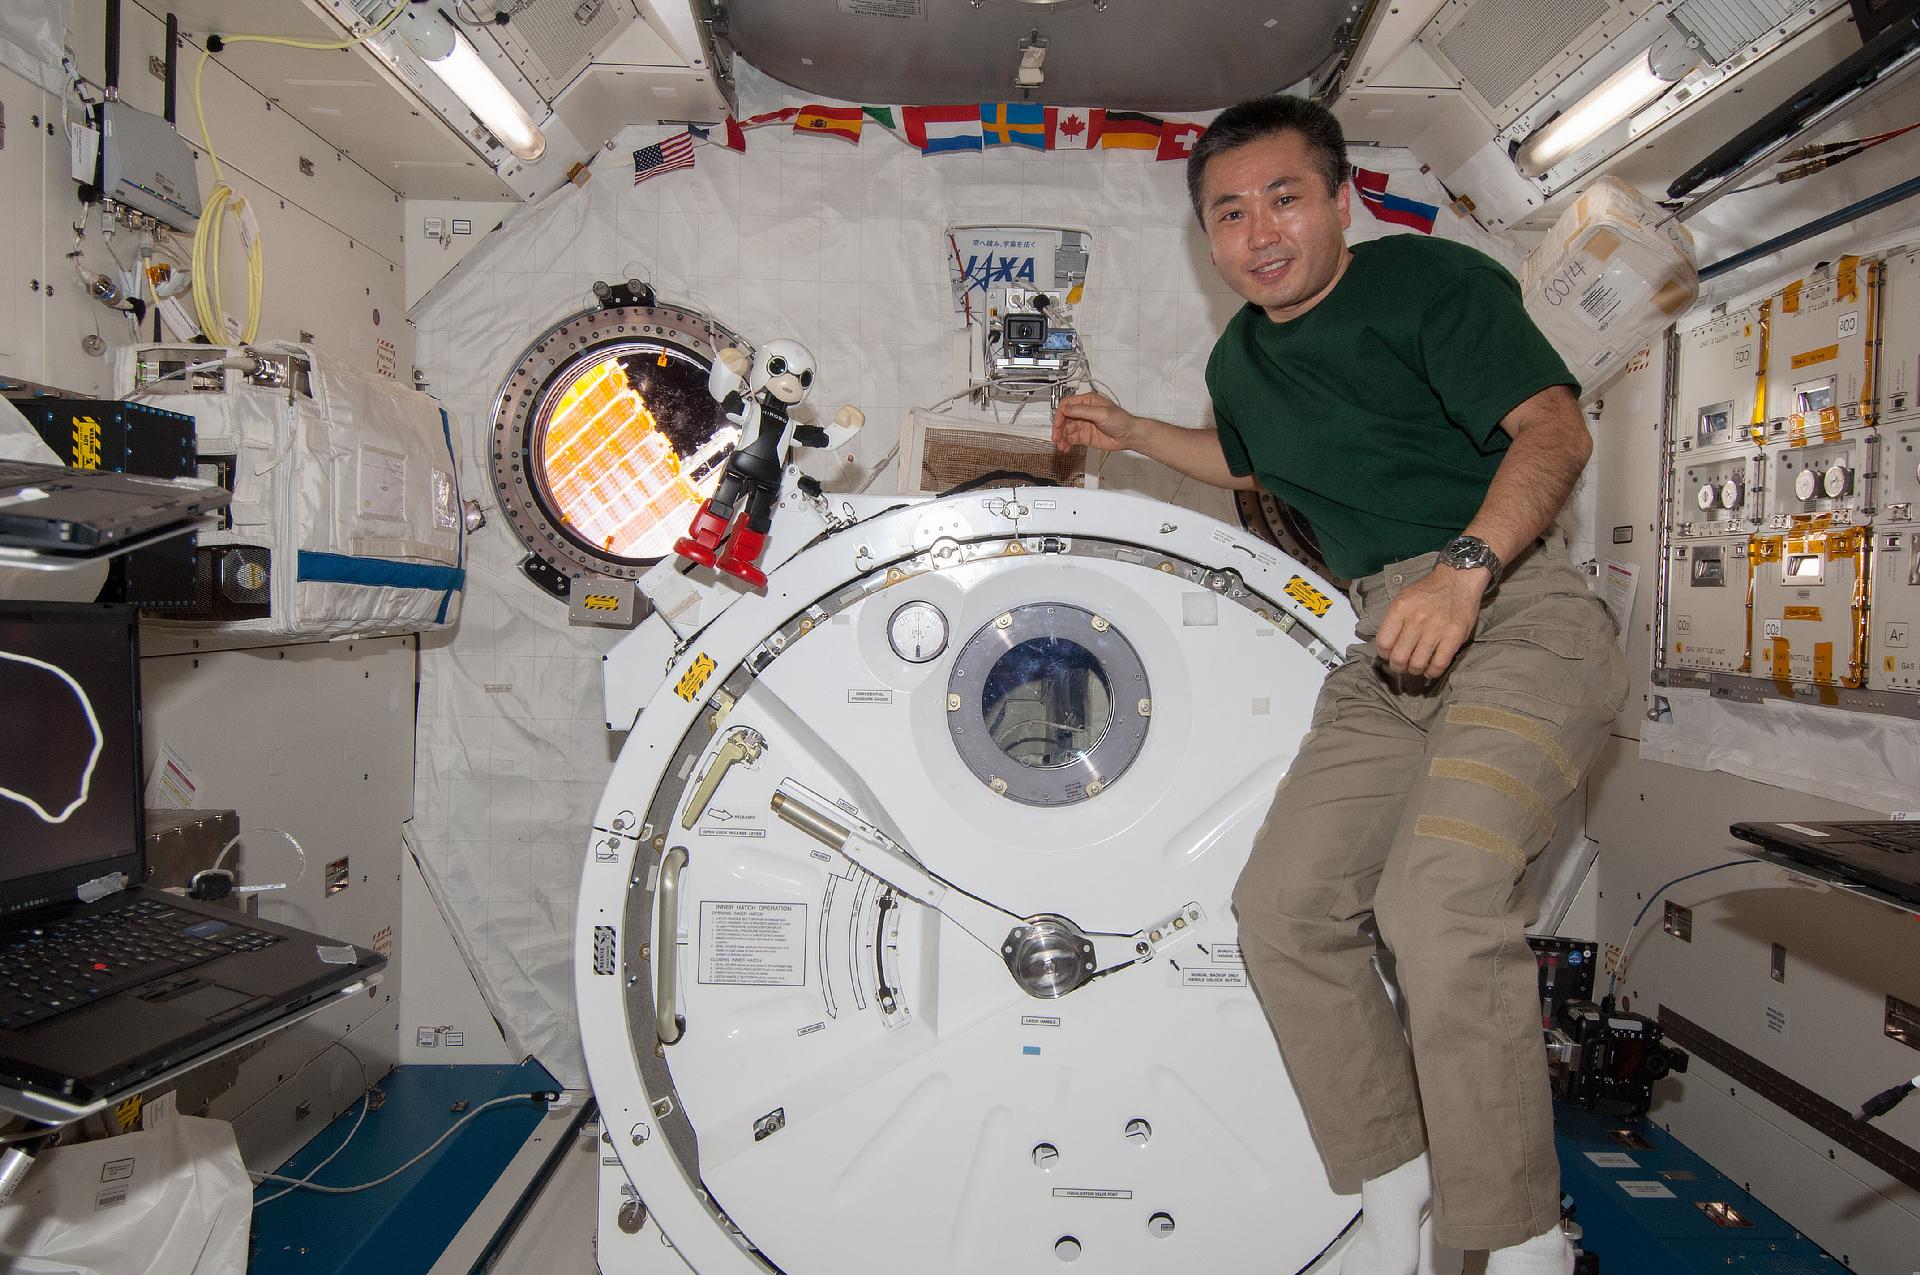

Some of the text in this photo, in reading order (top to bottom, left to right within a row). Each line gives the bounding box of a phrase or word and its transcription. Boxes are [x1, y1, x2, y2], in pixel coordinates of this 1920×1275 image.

[963, 250, 1035, 291] JAXA
[1544, 261, 1586, 306] 0014
[1839, 317, 1856, 332] CO2
[1735, 349, 1750, 362] CO2
[1677, 620, 1690, 631] CO2
[1765, 624, 1779, 636] CO2
[1890, 628, 1904, 641] Ar
[1789, 654, 1810, 662] BOTTLE
[1901, 662, 1915, 670] GAS
